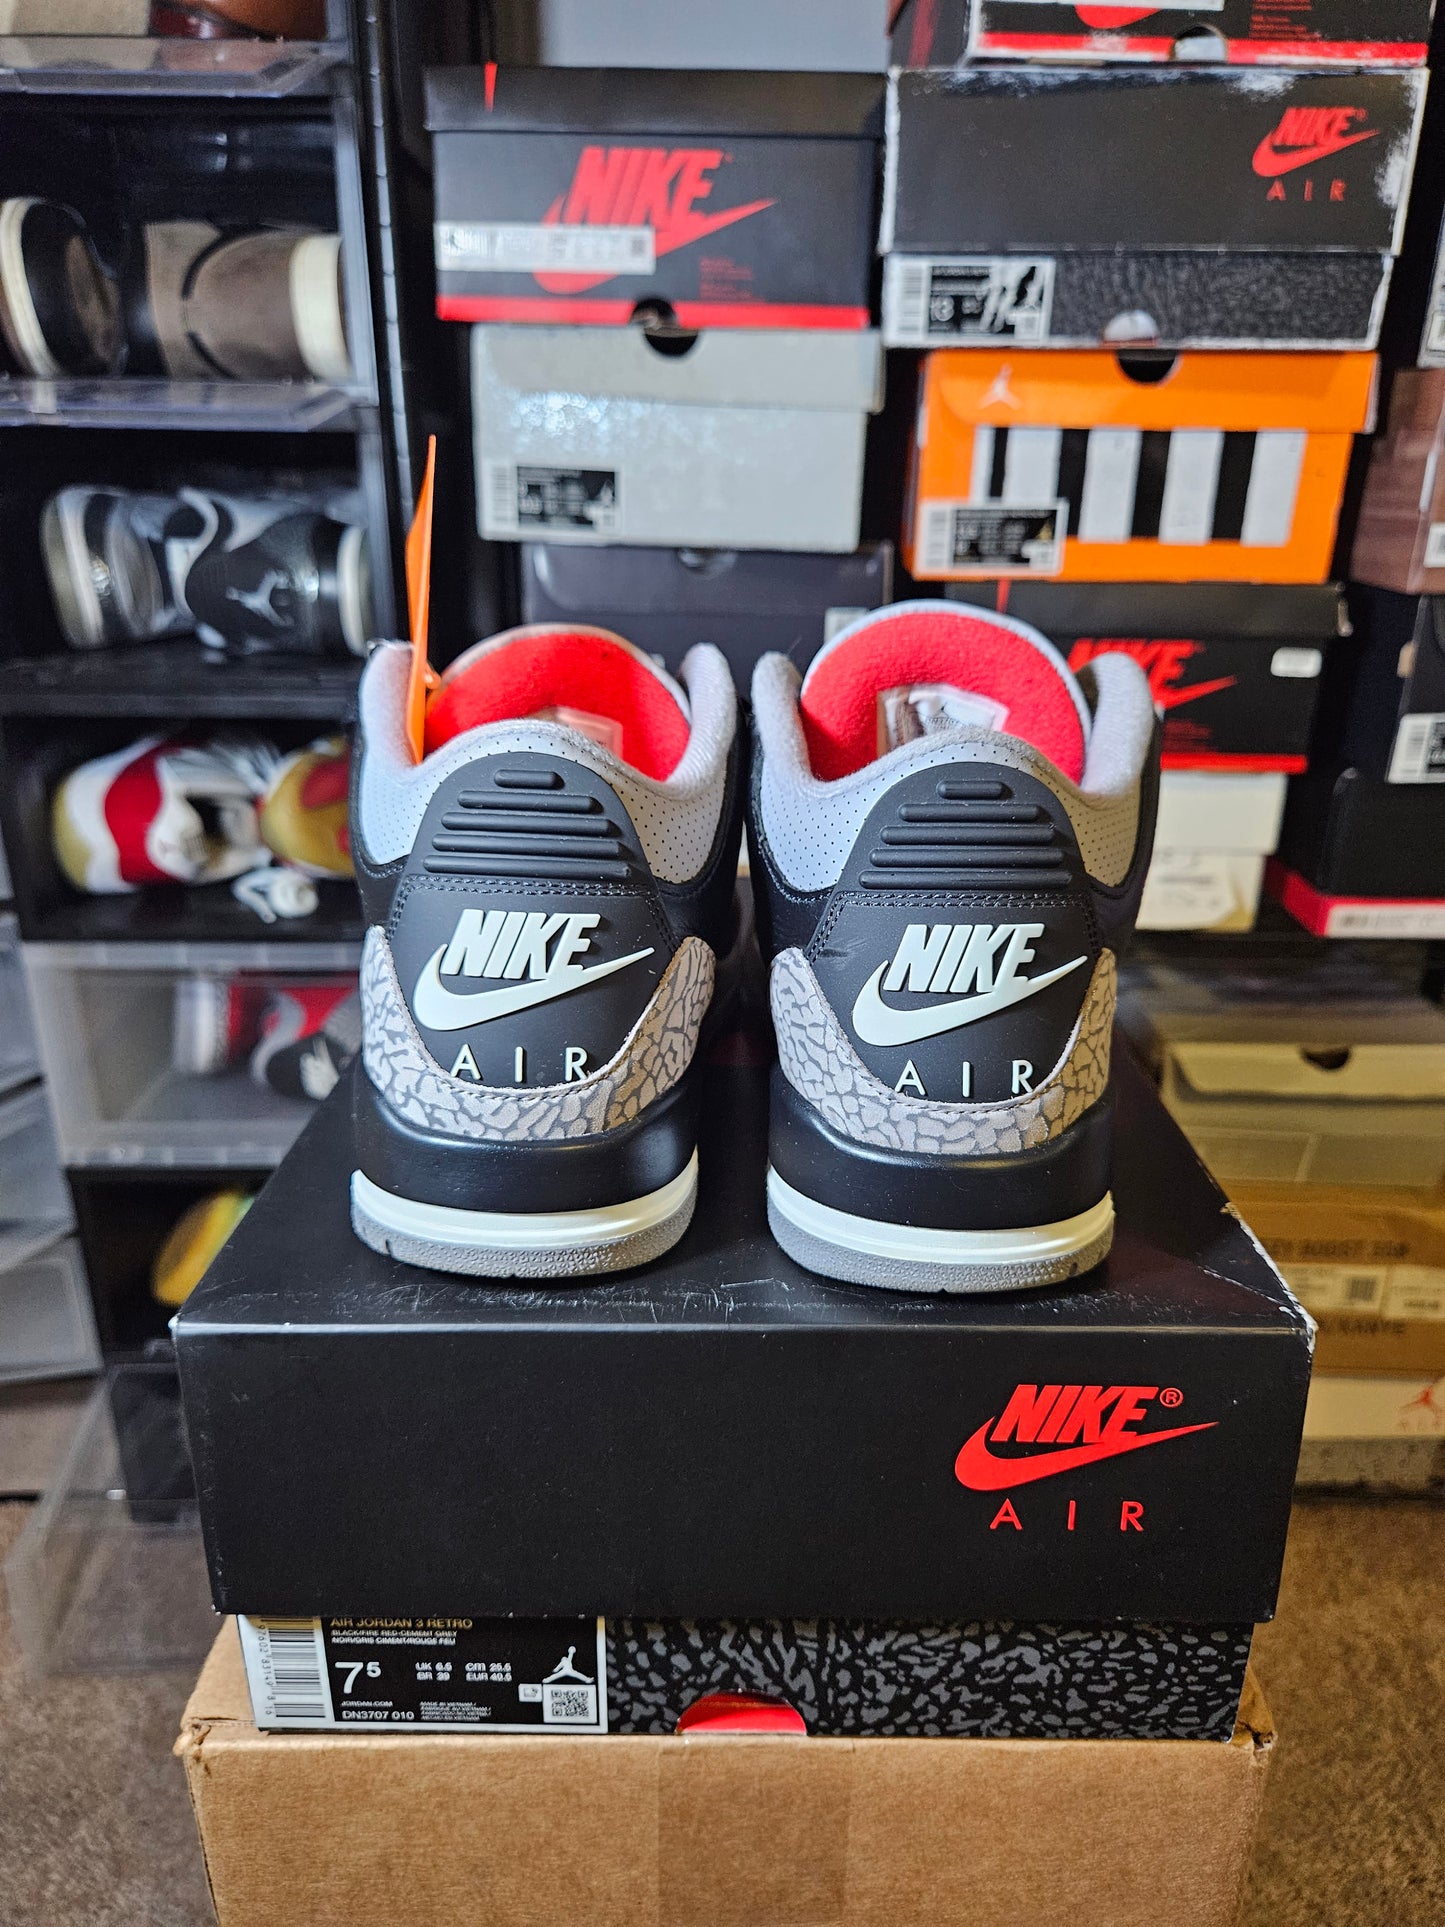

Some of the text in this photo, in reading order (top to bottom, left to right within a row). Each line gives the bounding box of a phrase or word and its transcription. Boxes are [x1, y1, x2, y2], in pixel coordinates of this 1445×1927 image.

[1272, 106, 1357, 146] NIKE
[561, 145, 723, 230] NIKE
[1266, 178, 1346, 201] AIR
[440, 909, 601, 980] NIKE
[883, 923, 1046, 993] NIKE
[450, 1043, 594, 1083] AIR
[894, 1059, 1037, 1098] AIR
[989, 1498, 1144, 1532] AIR
[330, 1618, 473, 1629] AIR JORDAN 3 RETRO
[415, 1662, 432, 1671] UK
[465, 1672, 488, 1682] EUR
[342, 1710, 389, 1720] DN3707
[391, 1711, 415, 1721] 010
